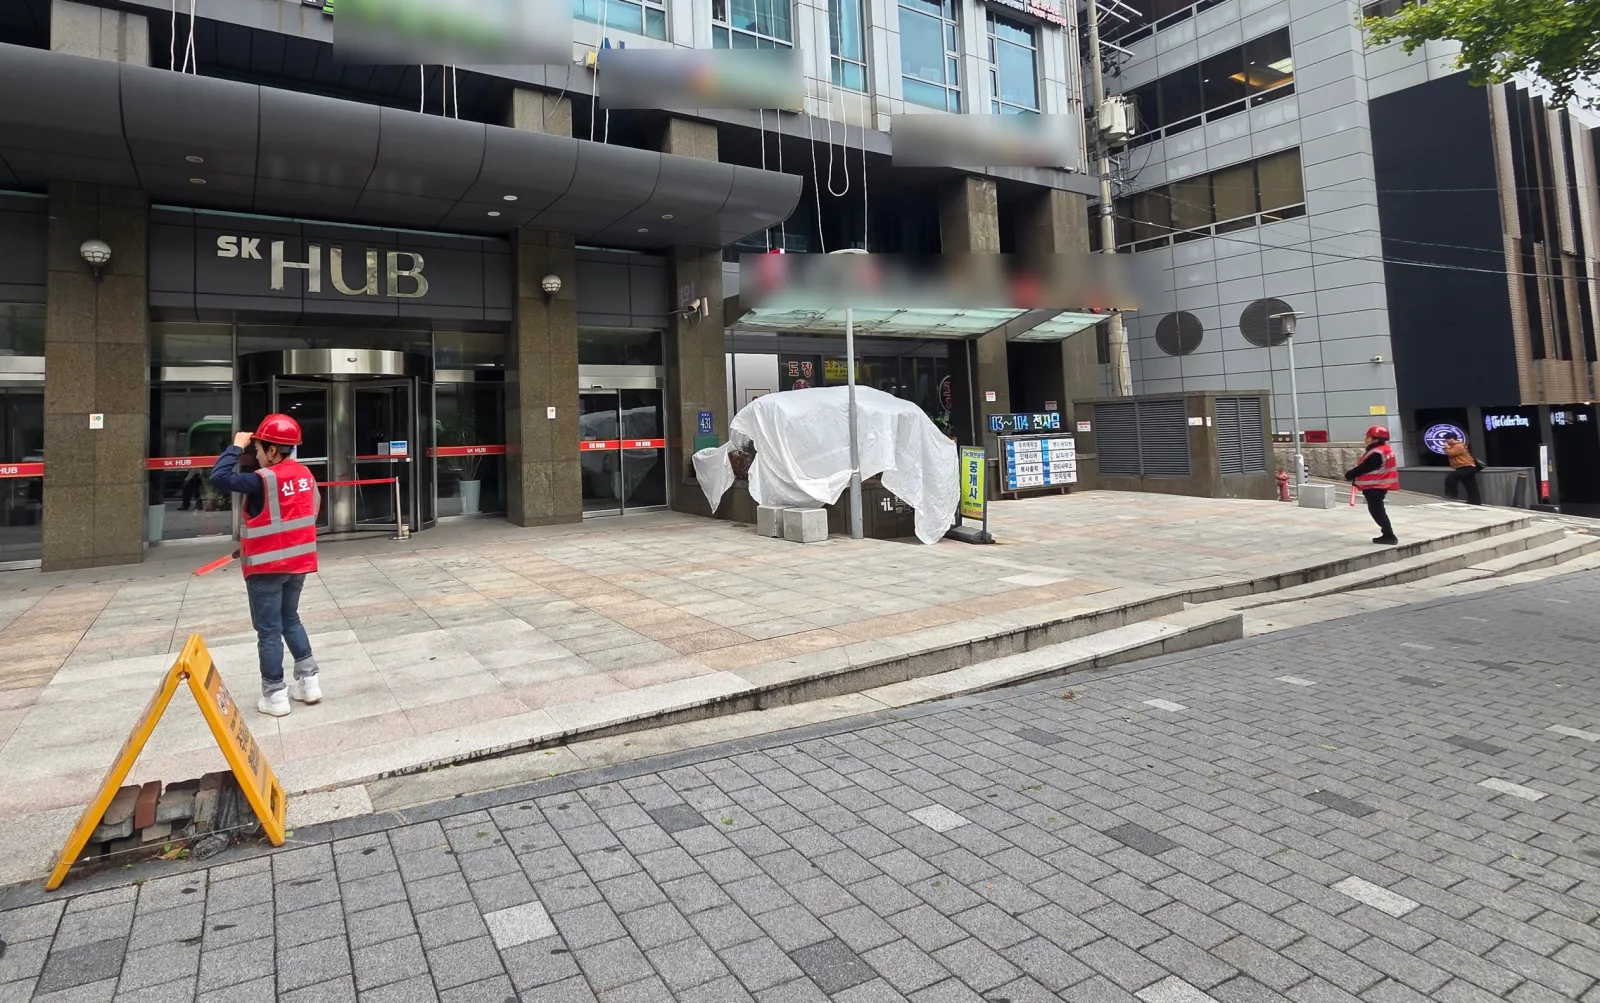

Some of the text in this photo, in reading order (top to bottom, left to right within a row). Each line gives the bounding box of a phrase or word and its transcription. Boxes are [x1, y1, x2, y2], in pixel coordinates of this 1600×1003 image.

[216, 235, 429, 298] SK HUB
[788, 361, 813, 378] 도장
[700, 417, 711, 429] 431
[991, 415, 1029, 431] 03~104
[281, 477, 313, 497] 신호
[968, 460, 978, 500] 중개사
